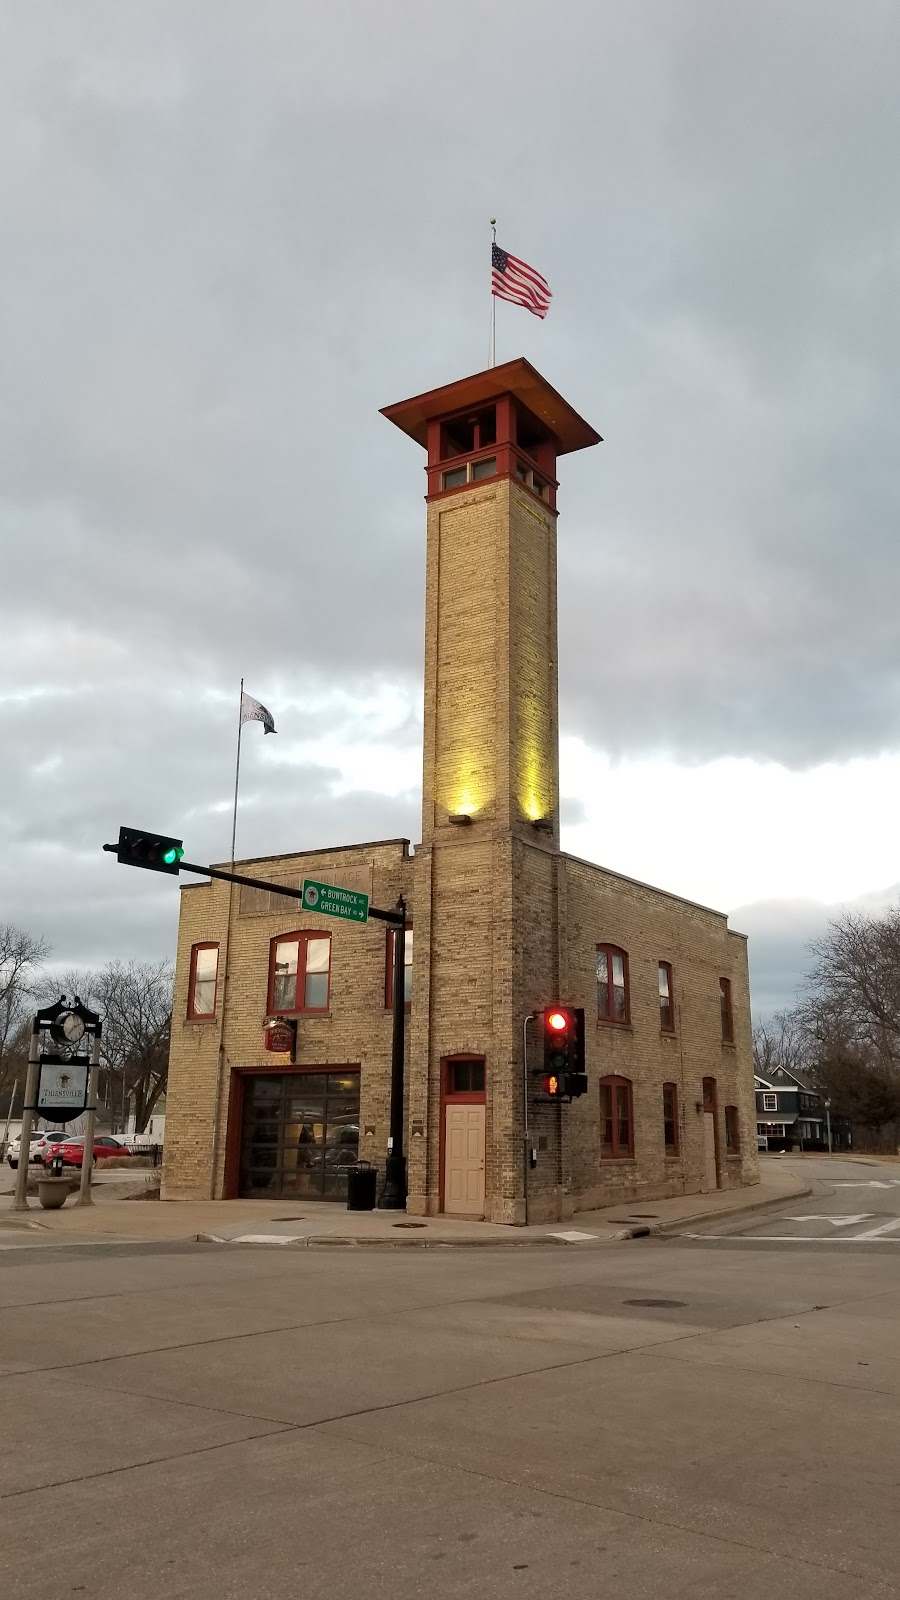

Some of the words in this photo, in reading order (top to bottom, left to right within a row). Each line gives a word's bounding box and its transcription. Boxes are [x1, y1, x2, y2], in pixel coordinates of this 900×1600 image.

[327, 889, 358, 904] BUNTROCK
[320, 901, 340, 912] GREEN
[340, 905, 352, 915] BAY
